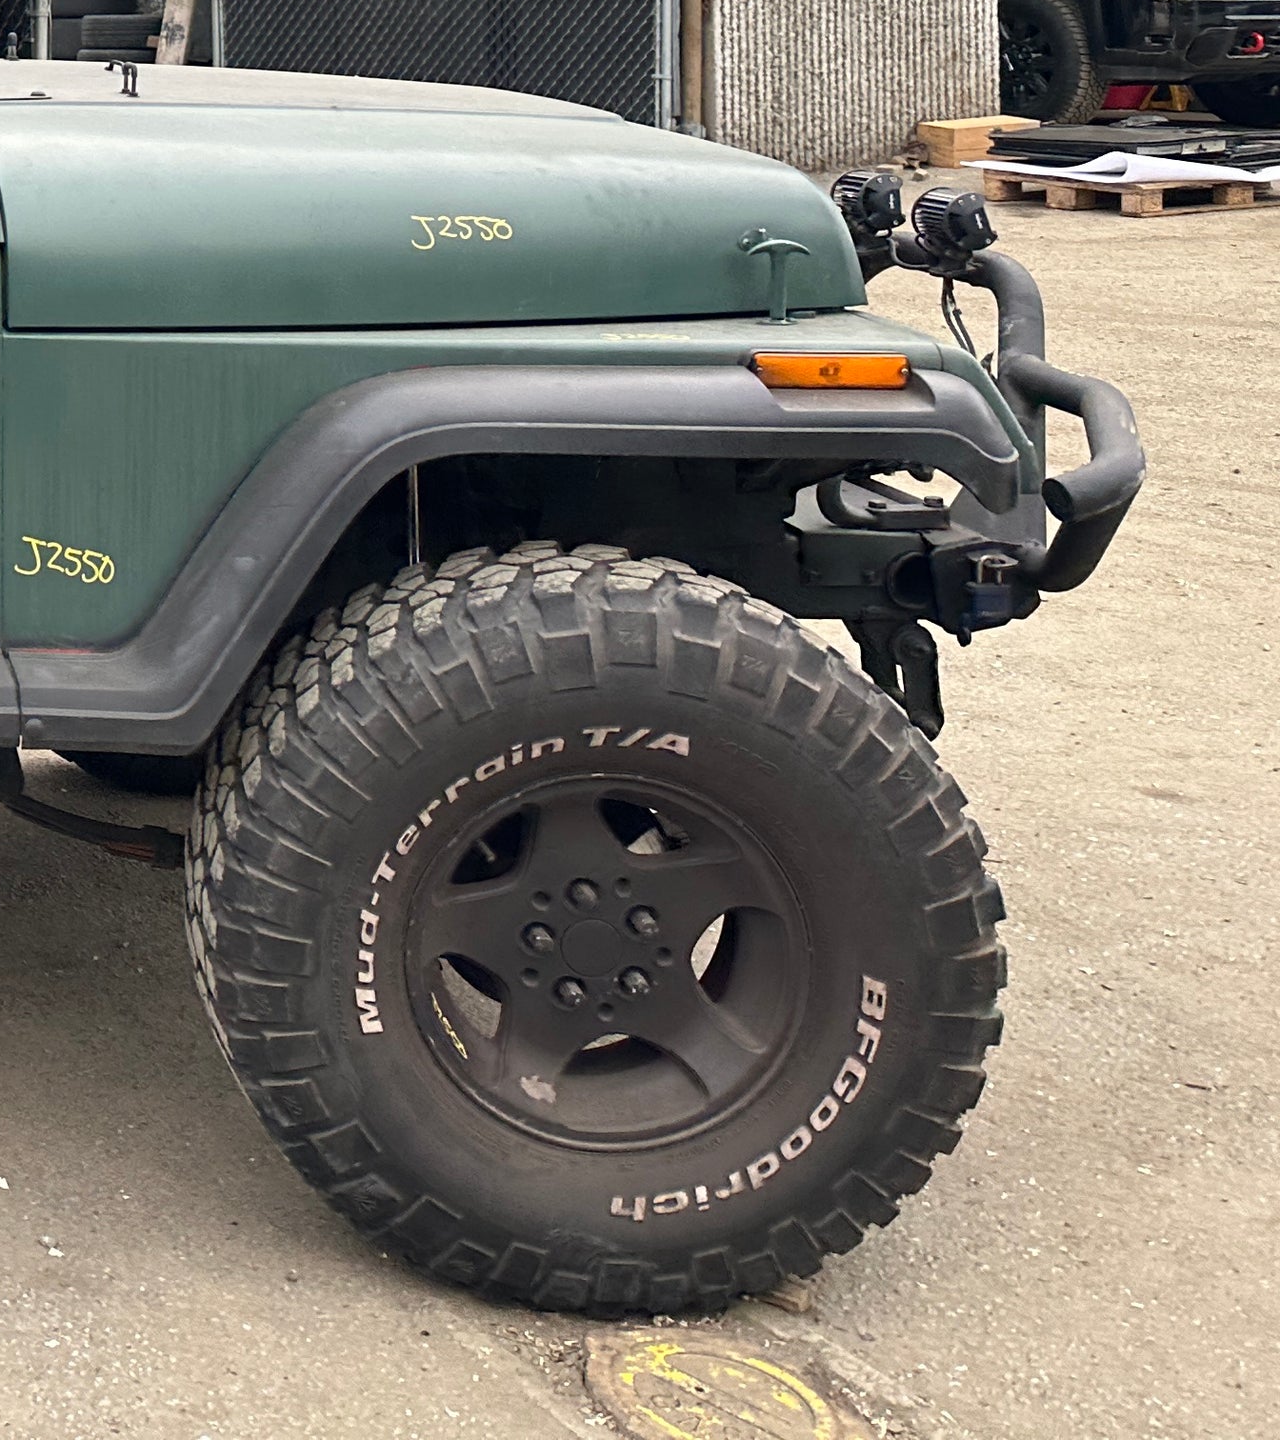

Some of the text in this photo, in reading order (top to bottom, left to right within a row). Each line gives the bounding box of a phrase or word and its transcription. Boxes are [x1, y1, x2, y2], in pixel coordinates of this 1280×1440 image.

[410, 215, 514, 250] J2550
[13, 535, 116, 584] J2550
[354, 735, 565, 1037] Mud-Terrain
[581, 726, 691, 758] T/A
[611, 974, 888, 1222] BFGoodrich
